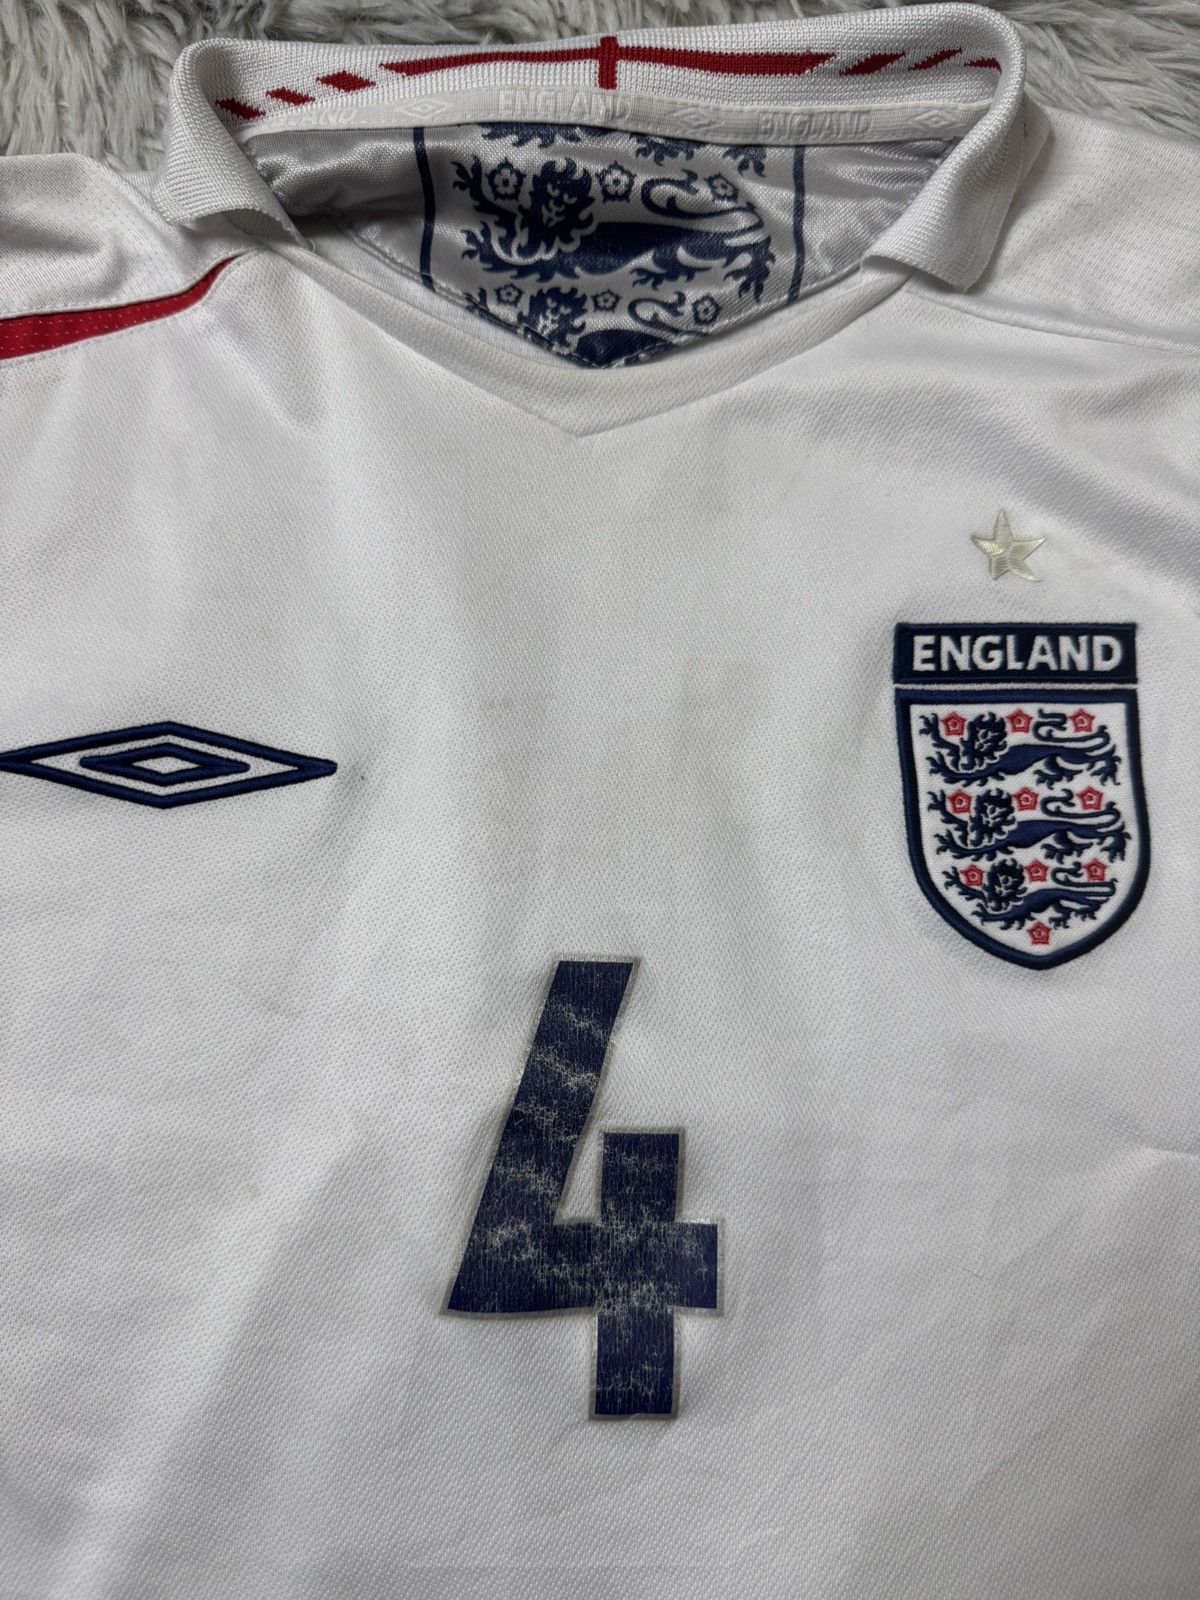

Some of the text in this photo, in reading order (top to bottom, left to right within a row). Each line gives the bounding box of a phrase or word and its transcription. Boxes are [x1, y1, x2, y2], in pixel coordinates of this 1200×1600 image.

[499, 89, 872, 140] ENGLAND ENGLAND
[912, 634, 1122, 672] ENGLAND
[441, 955, 723, 1419] 4
